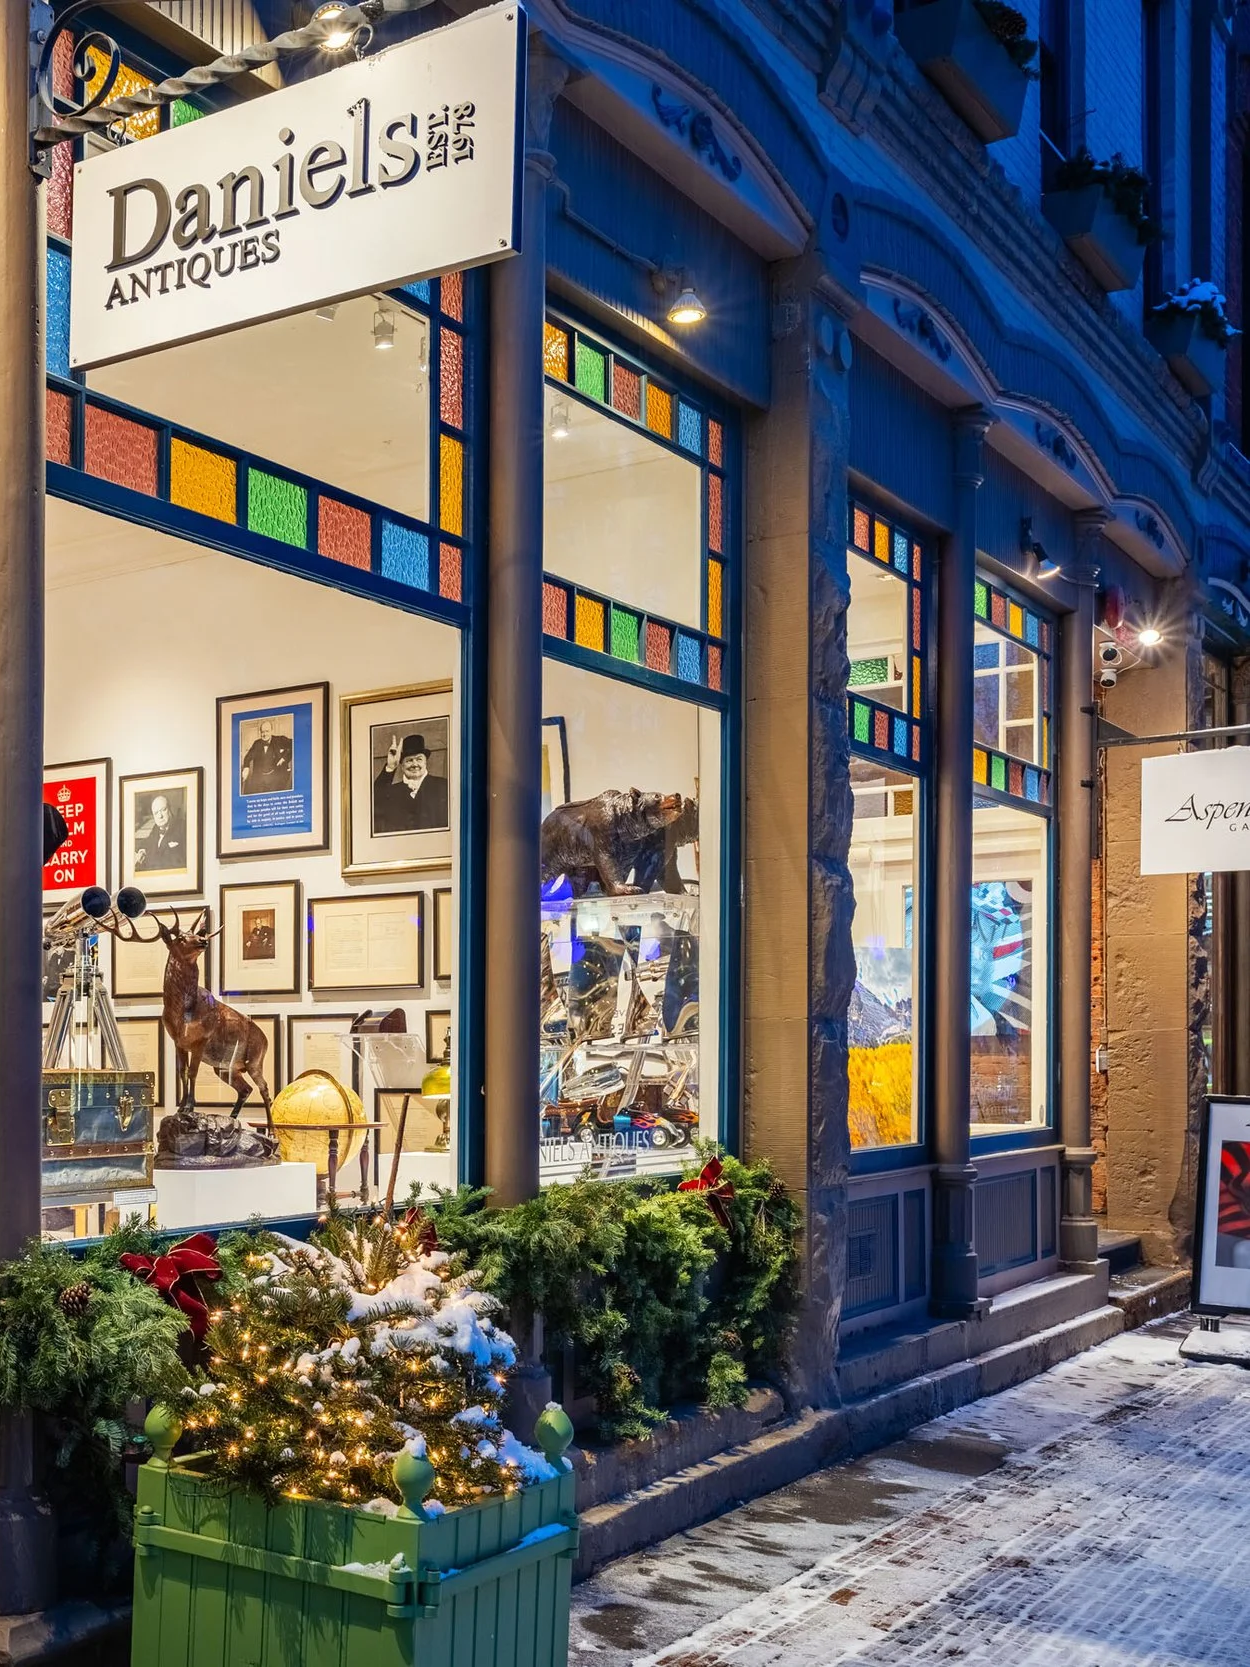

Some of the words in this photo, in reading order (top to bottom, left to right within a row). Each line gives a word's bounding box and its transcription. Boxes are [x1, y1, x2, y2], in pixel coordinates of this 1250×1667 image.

[426, 104, 450, 172] EST.
[451, 101, 476, 165] 1978
[104, 97, 422, 273] Daniels
[104, 229, 281, 310] ANTIQUES
[56, 803, 84, 819] EEP
[1164, 793, 1250, 830] Aspen
[44, 849, 89, 867] ARRY
[54, 868, 75, 883] ON
[580, 1130, 650, 1163] ANTIQUES
